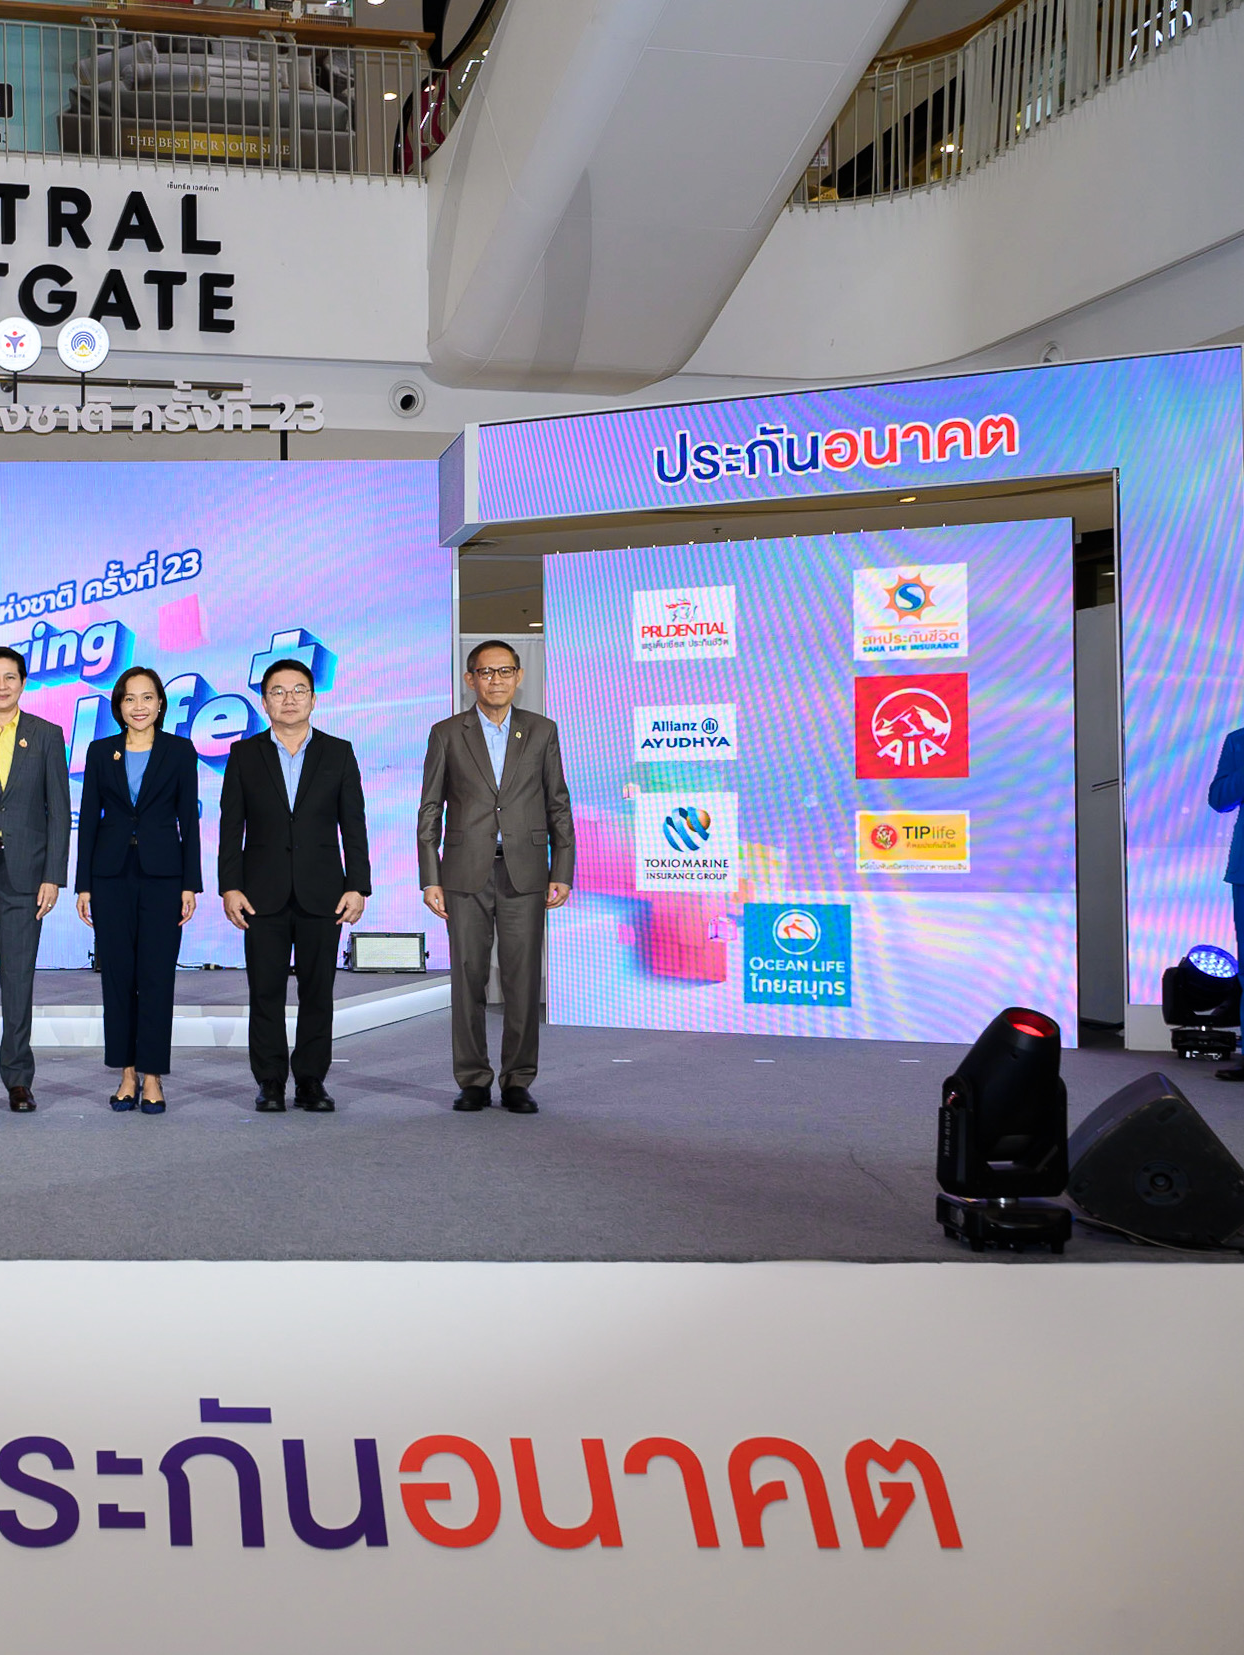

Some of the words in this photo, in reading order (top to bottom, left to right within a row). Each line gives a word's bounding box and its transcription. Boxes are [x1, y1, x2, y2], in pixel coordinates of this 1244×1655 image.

[127, 135, 155, 147] THE
[159, 137, 189, 149] BEST
[193, 139, 219, 151] FOR
[222, 141, 258, 154] YOUR
[132, 379, 252, 433] ครั้งที่
[269, 393, 325, 433] 23
[655, 415, 1017, 484] ประกันอนาคต
[84, 551, 157, 601] ครั้งที่
[164, 551, 200, 584] 23
[641, 621, 728, 639] PRUDENTIAL
[862, 629, 960, 646] สหประกันชีวิต
[889, 644, 908, 652] LIFE
[910, 642, 960, 651] INSURANCE
[651, 720, 698, 732] Allianz
[640, 736, 731, 749] AYUDHYA
[876, 738, 947, 767] AIA
[644, 858, 681, 868] TOKIO
[682, 858, 730, 868] MARINE
[646, 872, 695, 880] INSURANCE
[696, 872, 728, 881] GROUP
[748, 956, 809, 972] OCEAN
[812, 960, 847, 974] LIFE
[748, 972, 847, 1001] ไทยสมุทร
